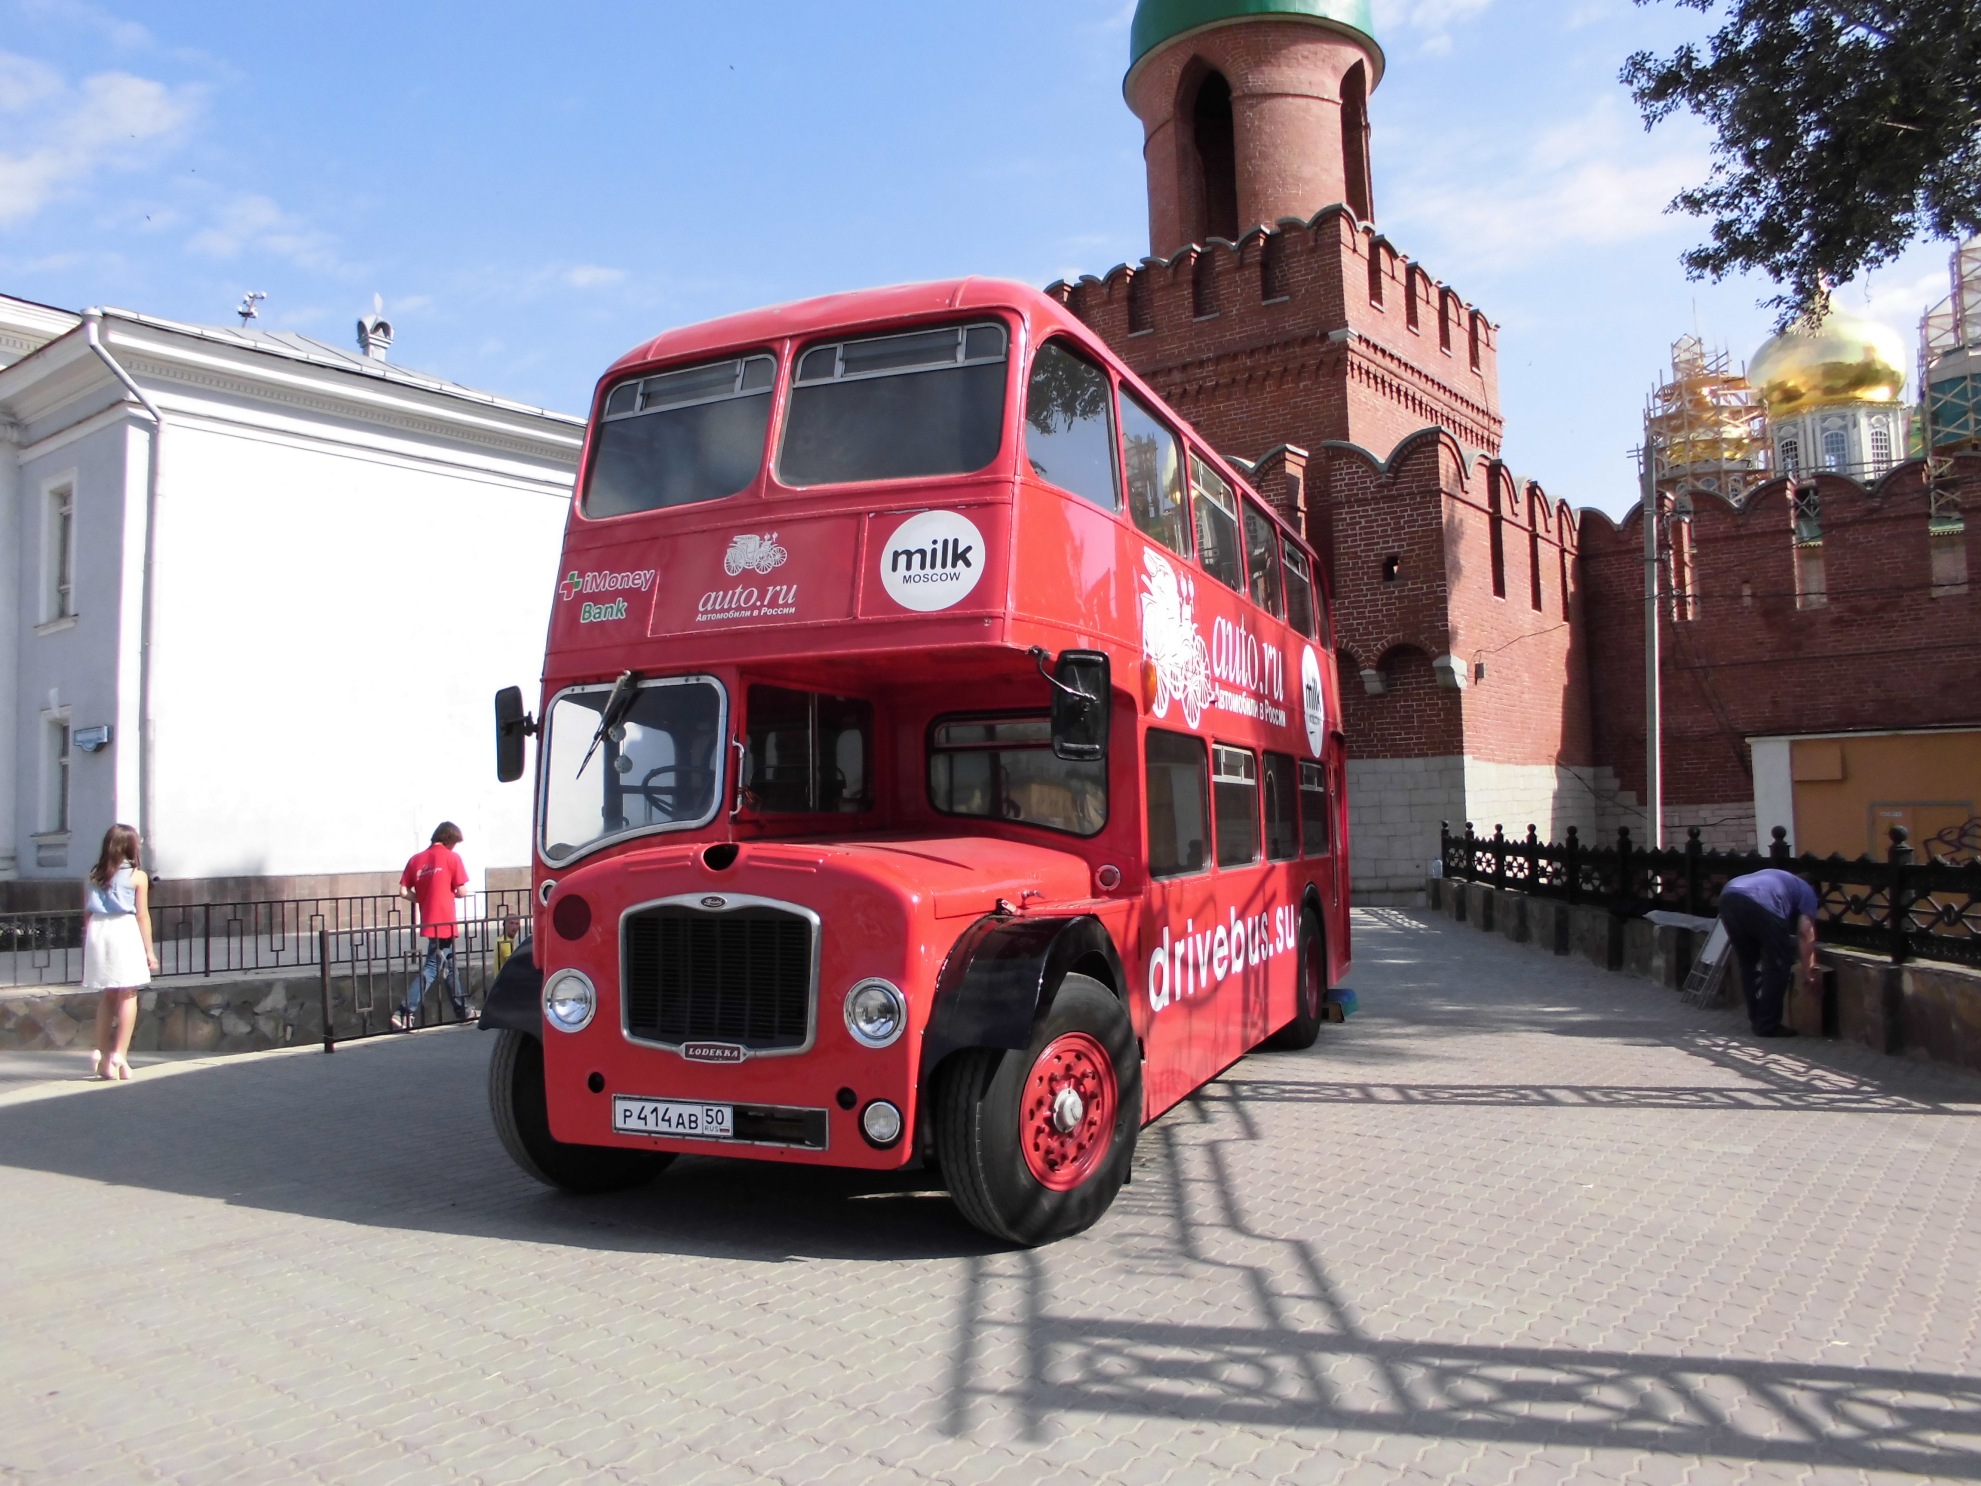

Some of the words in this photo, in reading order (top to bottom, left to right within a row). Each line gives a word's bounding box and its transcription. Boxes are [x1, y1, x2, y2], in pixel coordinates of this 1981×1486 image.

[891, 538, 974, 573] milk
[582, 569, 656, 593] iMoney
[902, 571, 962, 585] MOSCOW
[698, 582, 798, 612] auto.ru
[580, 597, 628, 623] Bank
[696, 608, 751, 622] Автомобили
[752, 609, 759, 617] в
[760, 605, 796, 616] России
[1212, 614, 1284, 702] auto.ru
[1215, 682, 1259, 719] Автомобили
[1259, 702, 1265, 720] в
[1265, 699, 1286, 727] России
[1149, 904, 1295, 1012] drivebus.su
[688, 1047, 738, 1058] LODEKKA
[704, 1125, 719, 1133] RUS
[705, 1108, 725, 1125] 50
